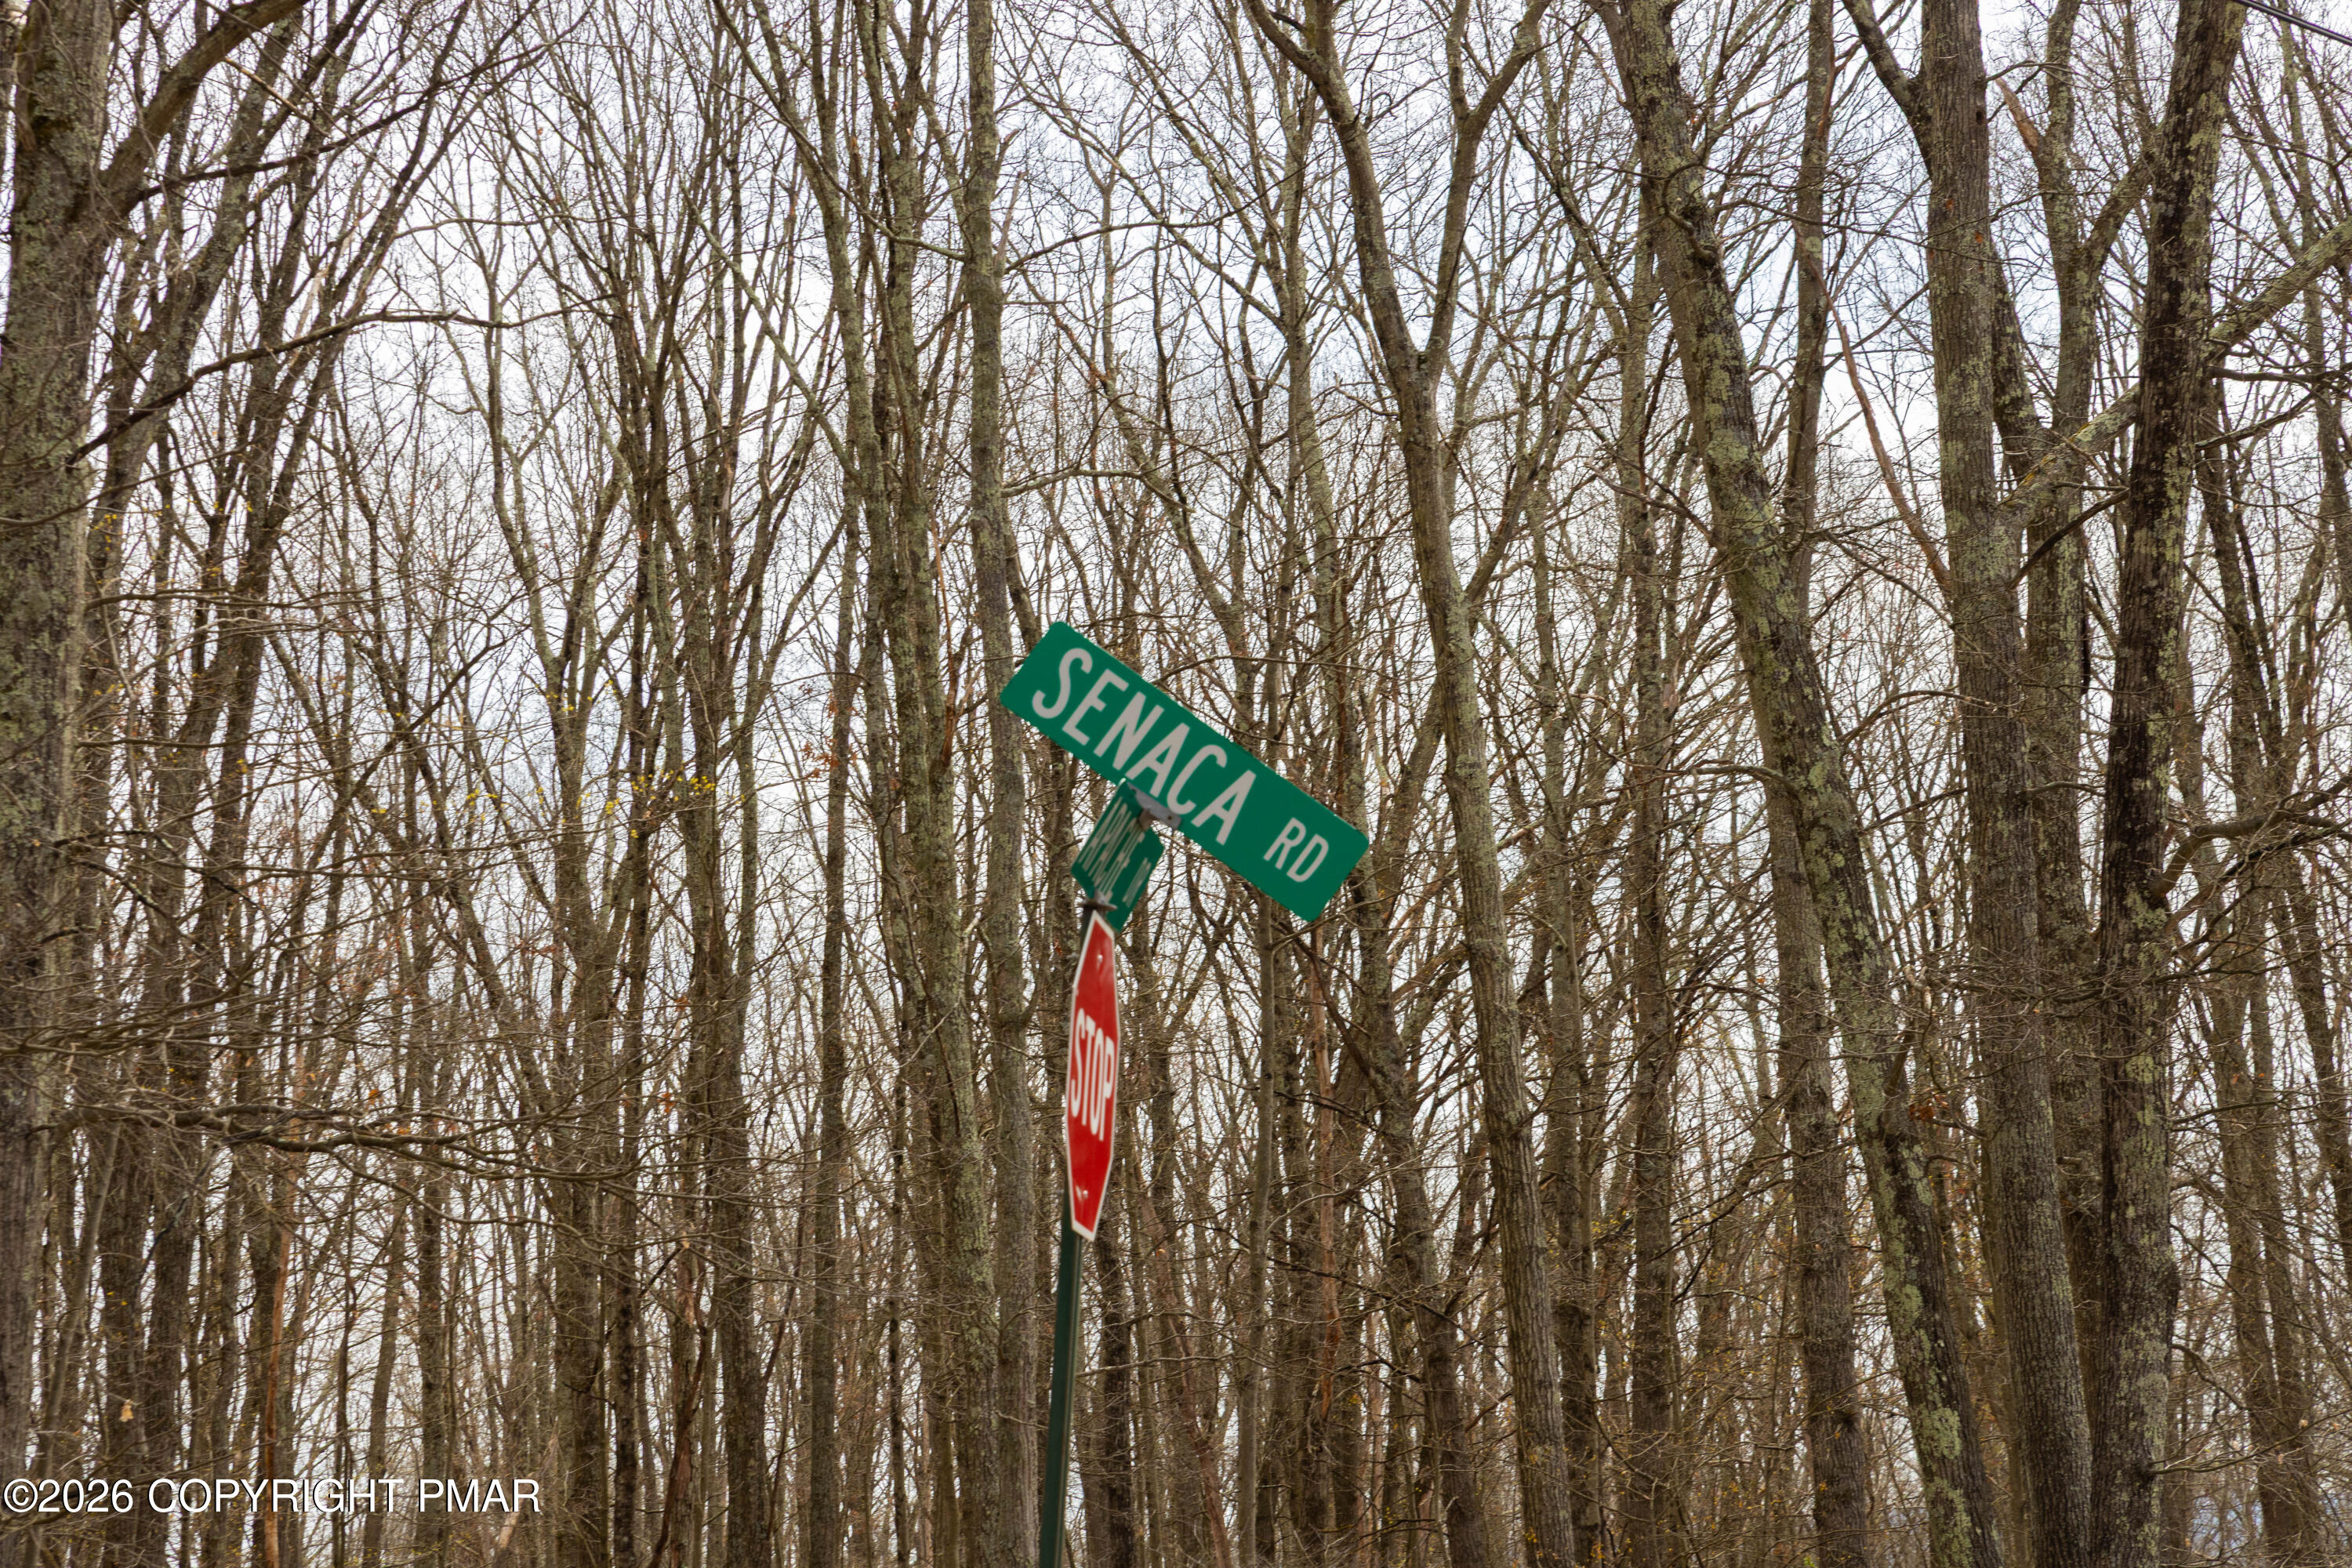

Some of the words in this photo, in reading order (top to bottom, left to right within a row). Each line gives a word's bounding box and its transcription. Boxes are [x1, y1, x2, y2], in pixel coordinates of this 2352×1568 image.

[1032, 648, 1257, 845] SENACA
[1263, 818, 1329, 883] RD
[1078, 796, 1145, 902] APACHE
[1071, 1008, 1115, 1142] STOP
